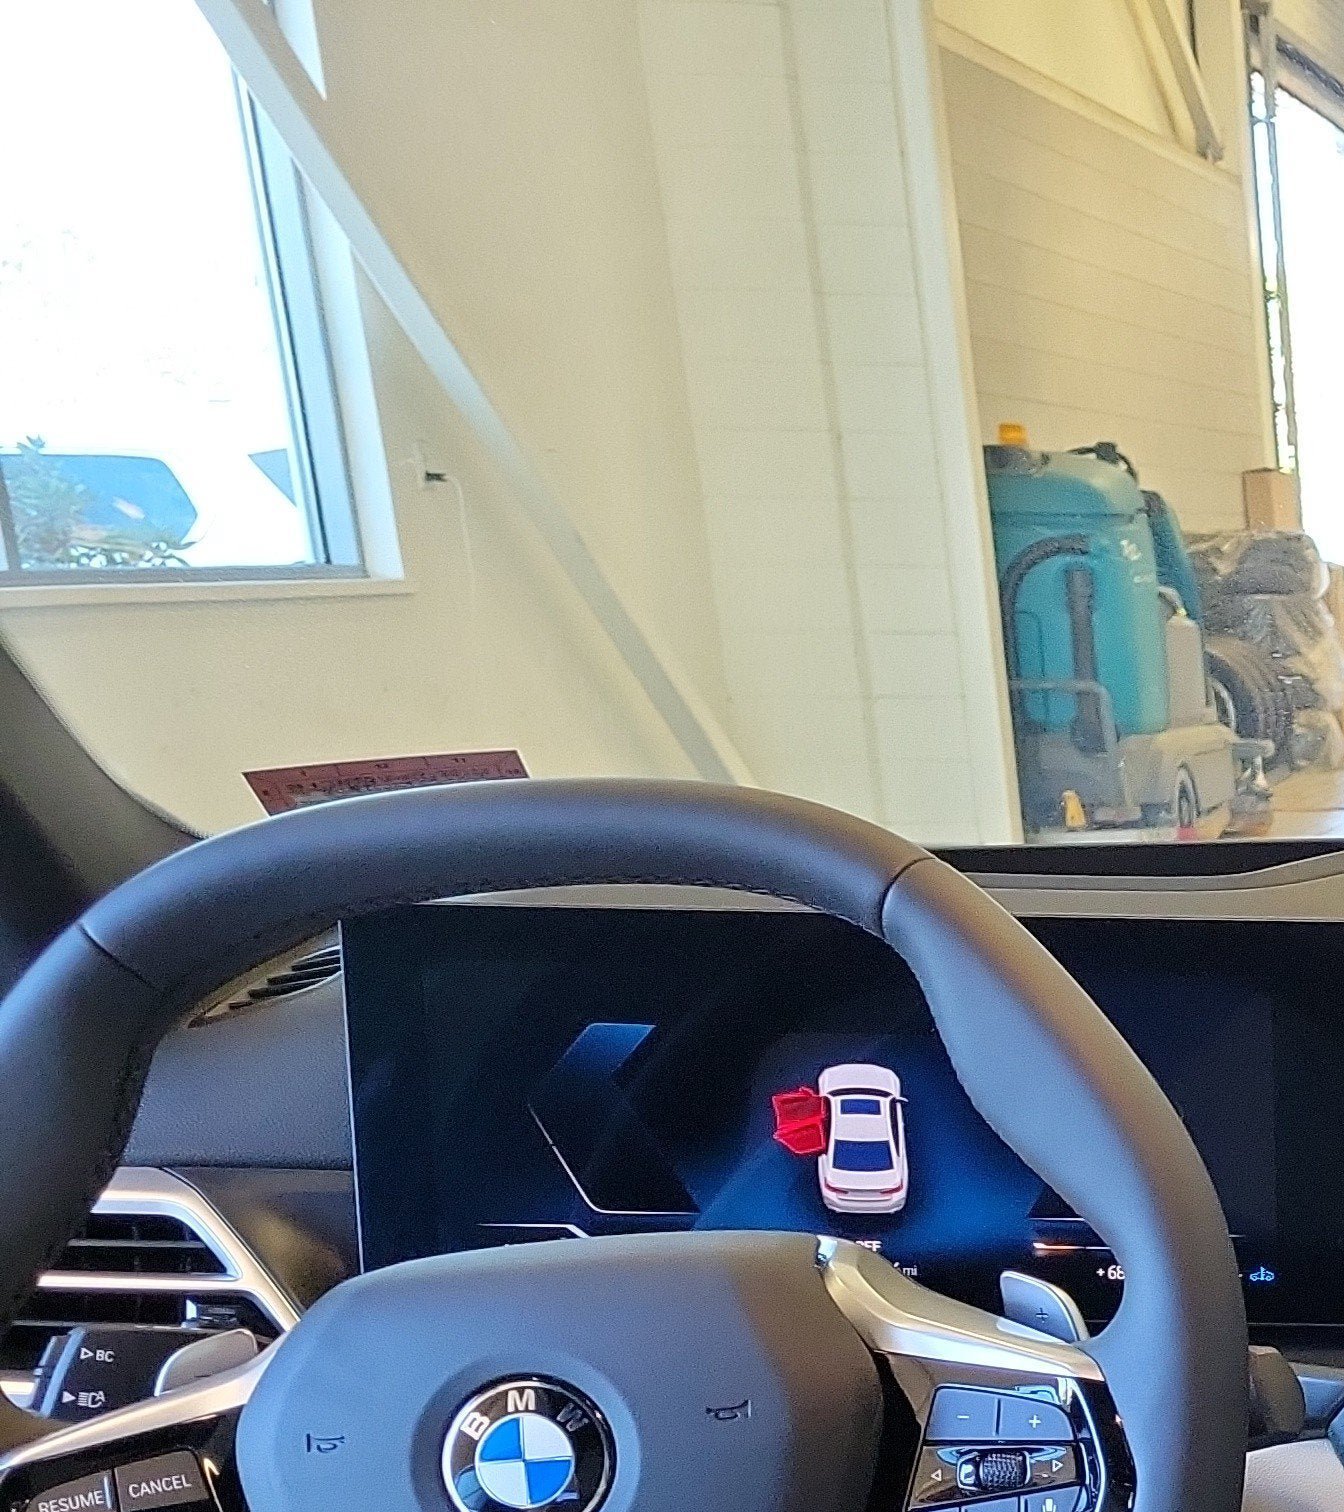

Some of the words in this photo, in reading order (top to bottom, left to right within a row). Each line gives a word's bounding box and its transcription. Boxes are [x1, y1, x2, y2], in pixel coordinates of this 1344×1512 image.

[95, 1349, 115, 1363] BC
[459, 1388, 590, 1442] BMW
[128, 1472, 192, 1499] CANCEL
